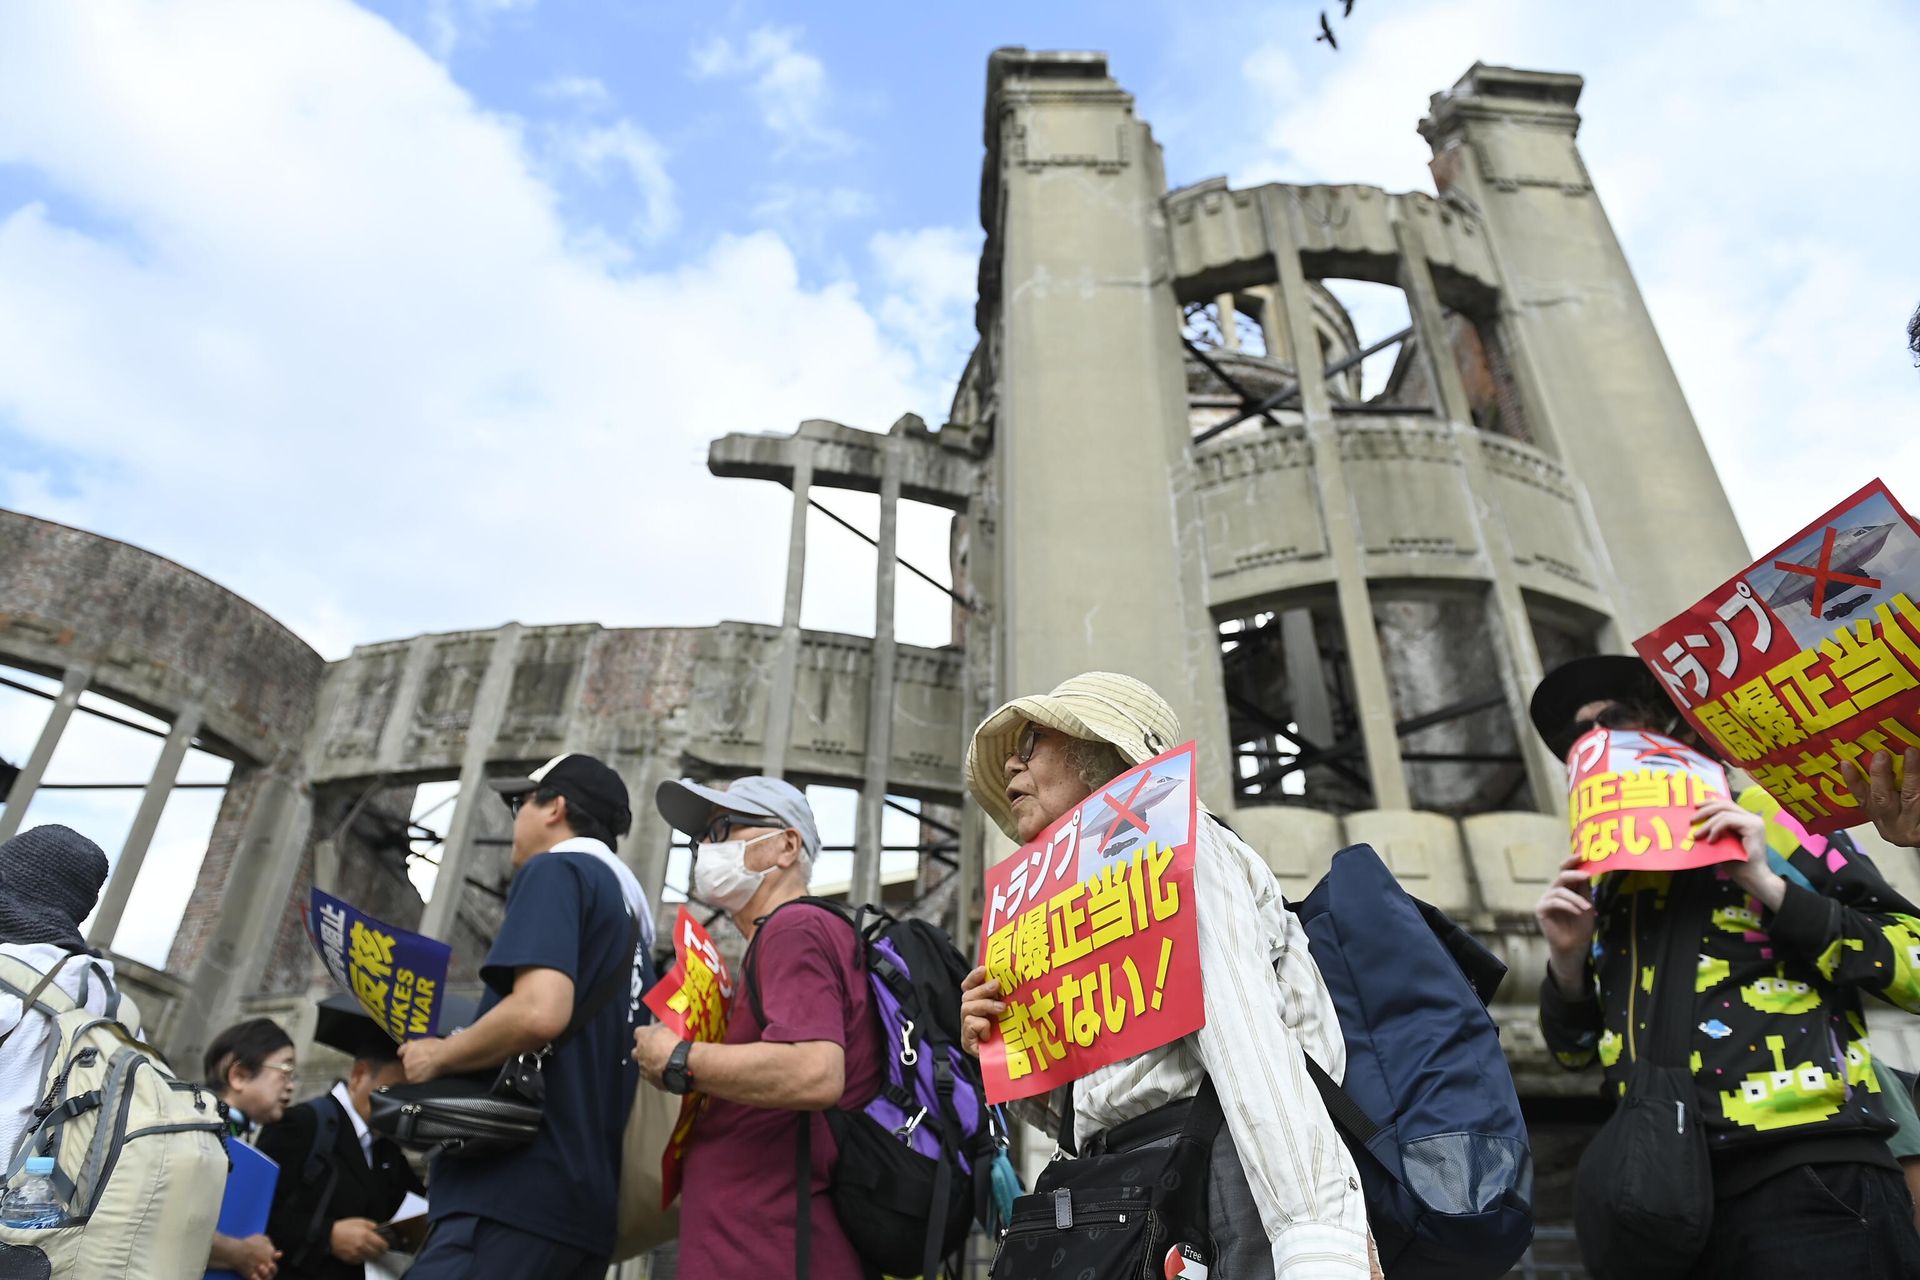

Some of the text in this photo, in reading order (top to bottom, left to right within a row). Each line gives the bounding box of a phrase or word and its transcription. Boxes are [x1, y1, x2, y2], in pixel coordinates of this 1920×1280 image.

[1651, 581, 1772, 709] トランプ
[1569, 768, 1717, 835] 正当化
[984, 841, 1180, 995] 原爆正当化
[987, 809, 1081, 937] トランプ
[389, 968, 415, 1040] UKES
[408, 976, 436, 1034] WAR
[999, 937, 1173, 1080] 許さない!
[1184, 1244, 1202, 1262] Free
